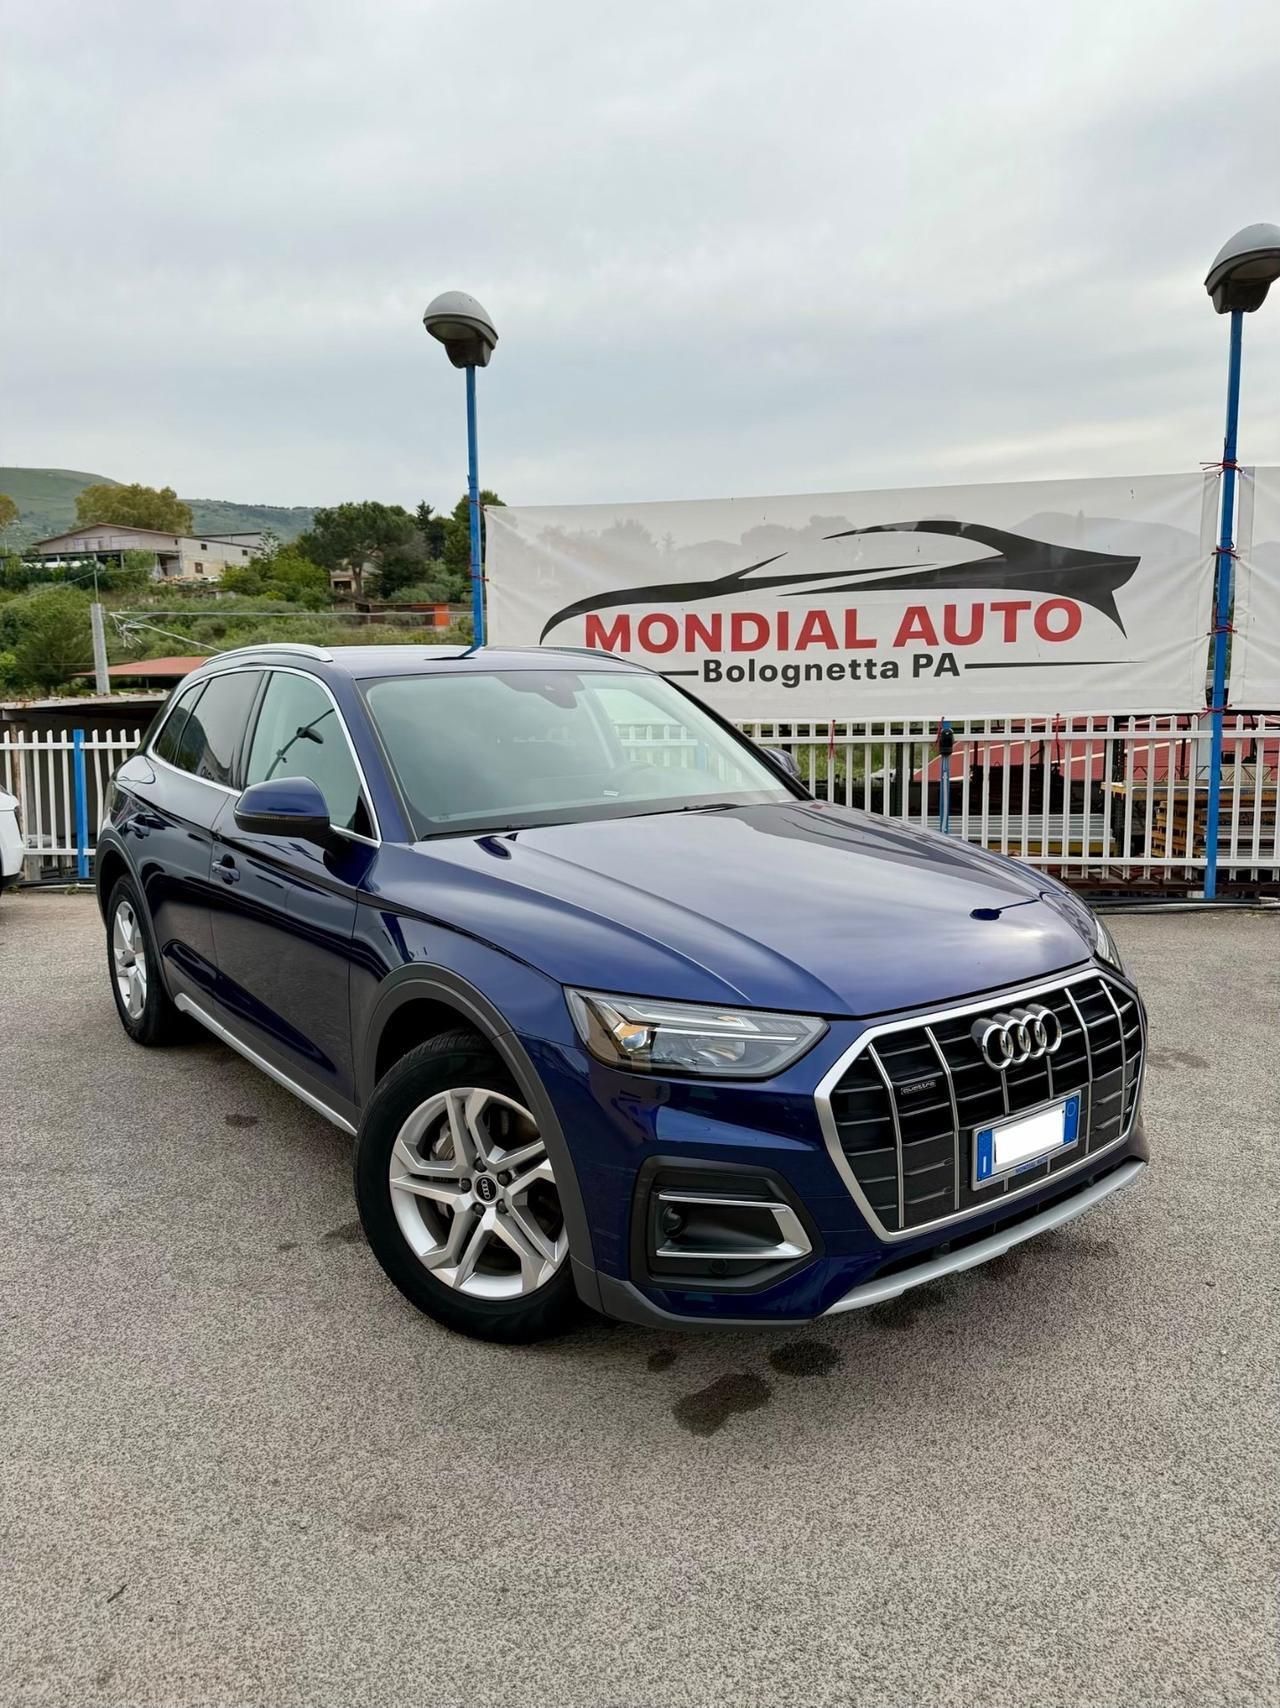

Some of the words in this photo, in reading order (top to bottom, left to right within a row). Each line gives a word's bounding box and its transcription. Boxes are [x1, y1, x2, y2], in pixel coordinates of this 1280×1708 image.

[584, 608, 878, 654] MONDIAL
[893, 598, 1082, 647] AUTO
[703, 658, 899, 688] Bolognetta
[913, 653, 960, 678] PA
